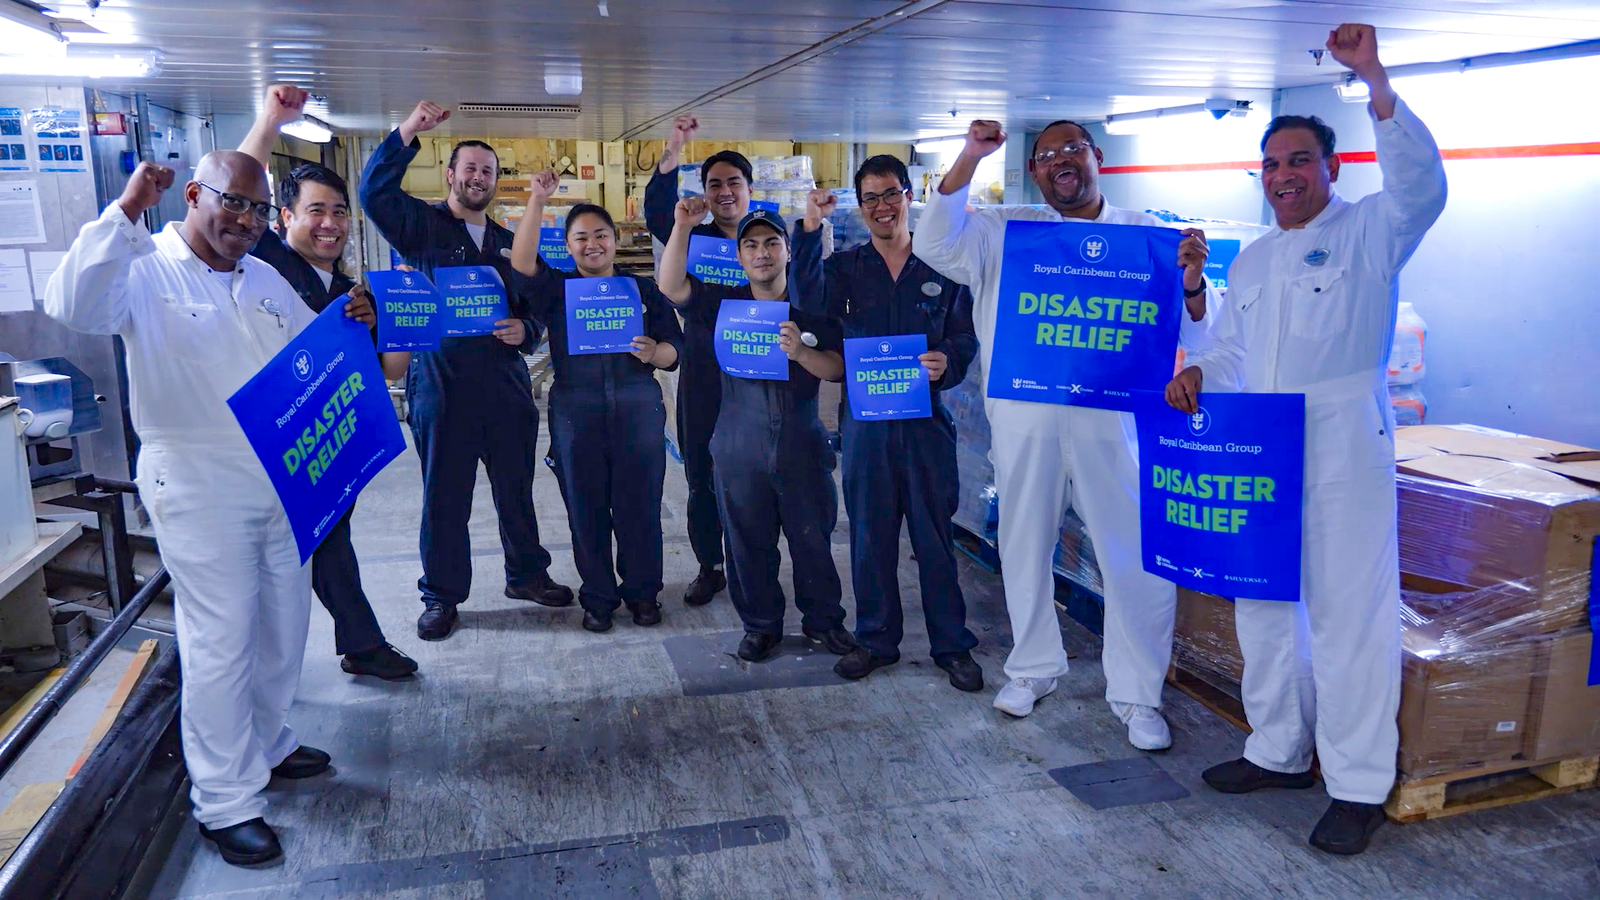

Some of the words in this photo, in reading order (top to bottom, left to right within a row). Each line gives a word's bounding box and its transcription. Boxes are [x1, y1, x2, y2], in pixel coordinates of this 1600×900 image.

[582, 169, 594, 177] 1.09
[695, 264, 749, 280] DISASTER
[1033, 264, 1061, 275] Royal
[1063, 266, 1116, 278] Caribbean
[1118, 270, 1151, 281] Group
[446, 294, 501, 307] DISASTER
[385, 302, 437, 314] DISASTER
[455, 306, 493, 318] RELIEF
[575, 306, 635, 319] DISASTER
[1018, 292, 1159, 325] DISASTER
[395, 315, 429, 327] RELIEF
[586, 319, 626, 331] RELIEF
[723, 329, 780, 344] DISASTER
[1036, 322, 1132, 352] RELIEF
[732, 343, 771, 356] RELIEF
[856, 368, 920, 382] DISASTER
[275, 403, 298, 429] Royal
[295, 371, 328, 407] Caribbean
[326, 351, 345, 373] Group
[868, 382, 910, 395] RELIEF
[1070, 384, 1081, 394] X
[282, 371, 366, 476] DISASTER
[306, 408, 358, 486] RELIEF
[1159, 436, 1178, 448] Royal
[1178, 439, 1222, 452] Caribbean
[1225, 442, 1262, 455] Group
[1152, 465, 1276, 502] DISASTER
[1166, 498, 1248, 534] RELIEF
[1193, 567, 1203, 578] X
[1229, 576, 1268, 584] SILVERSEA
